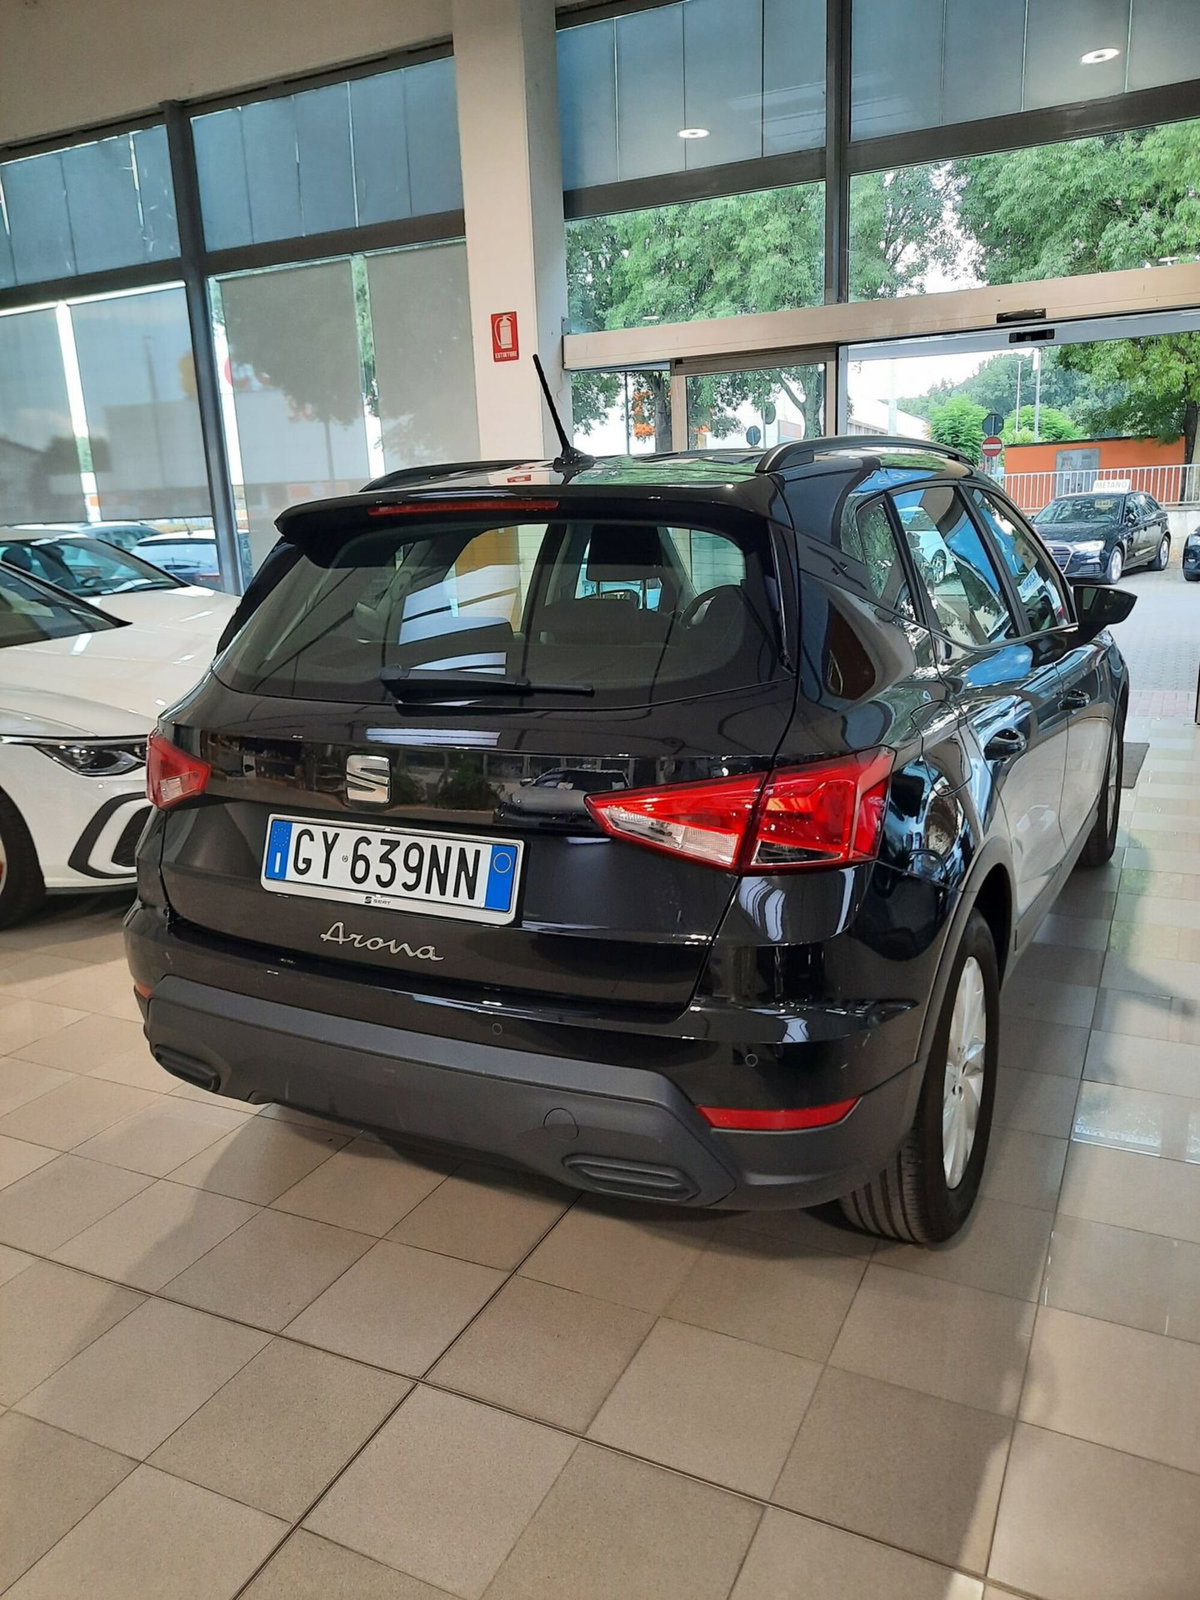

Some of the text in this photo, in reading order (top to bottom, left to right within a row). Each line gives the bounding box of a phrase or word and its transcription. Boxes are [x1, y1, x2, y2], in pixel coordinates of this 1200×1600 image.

[293, 828, 481, 900] GY 639NN
[320, 921, 445, 961] Arona
